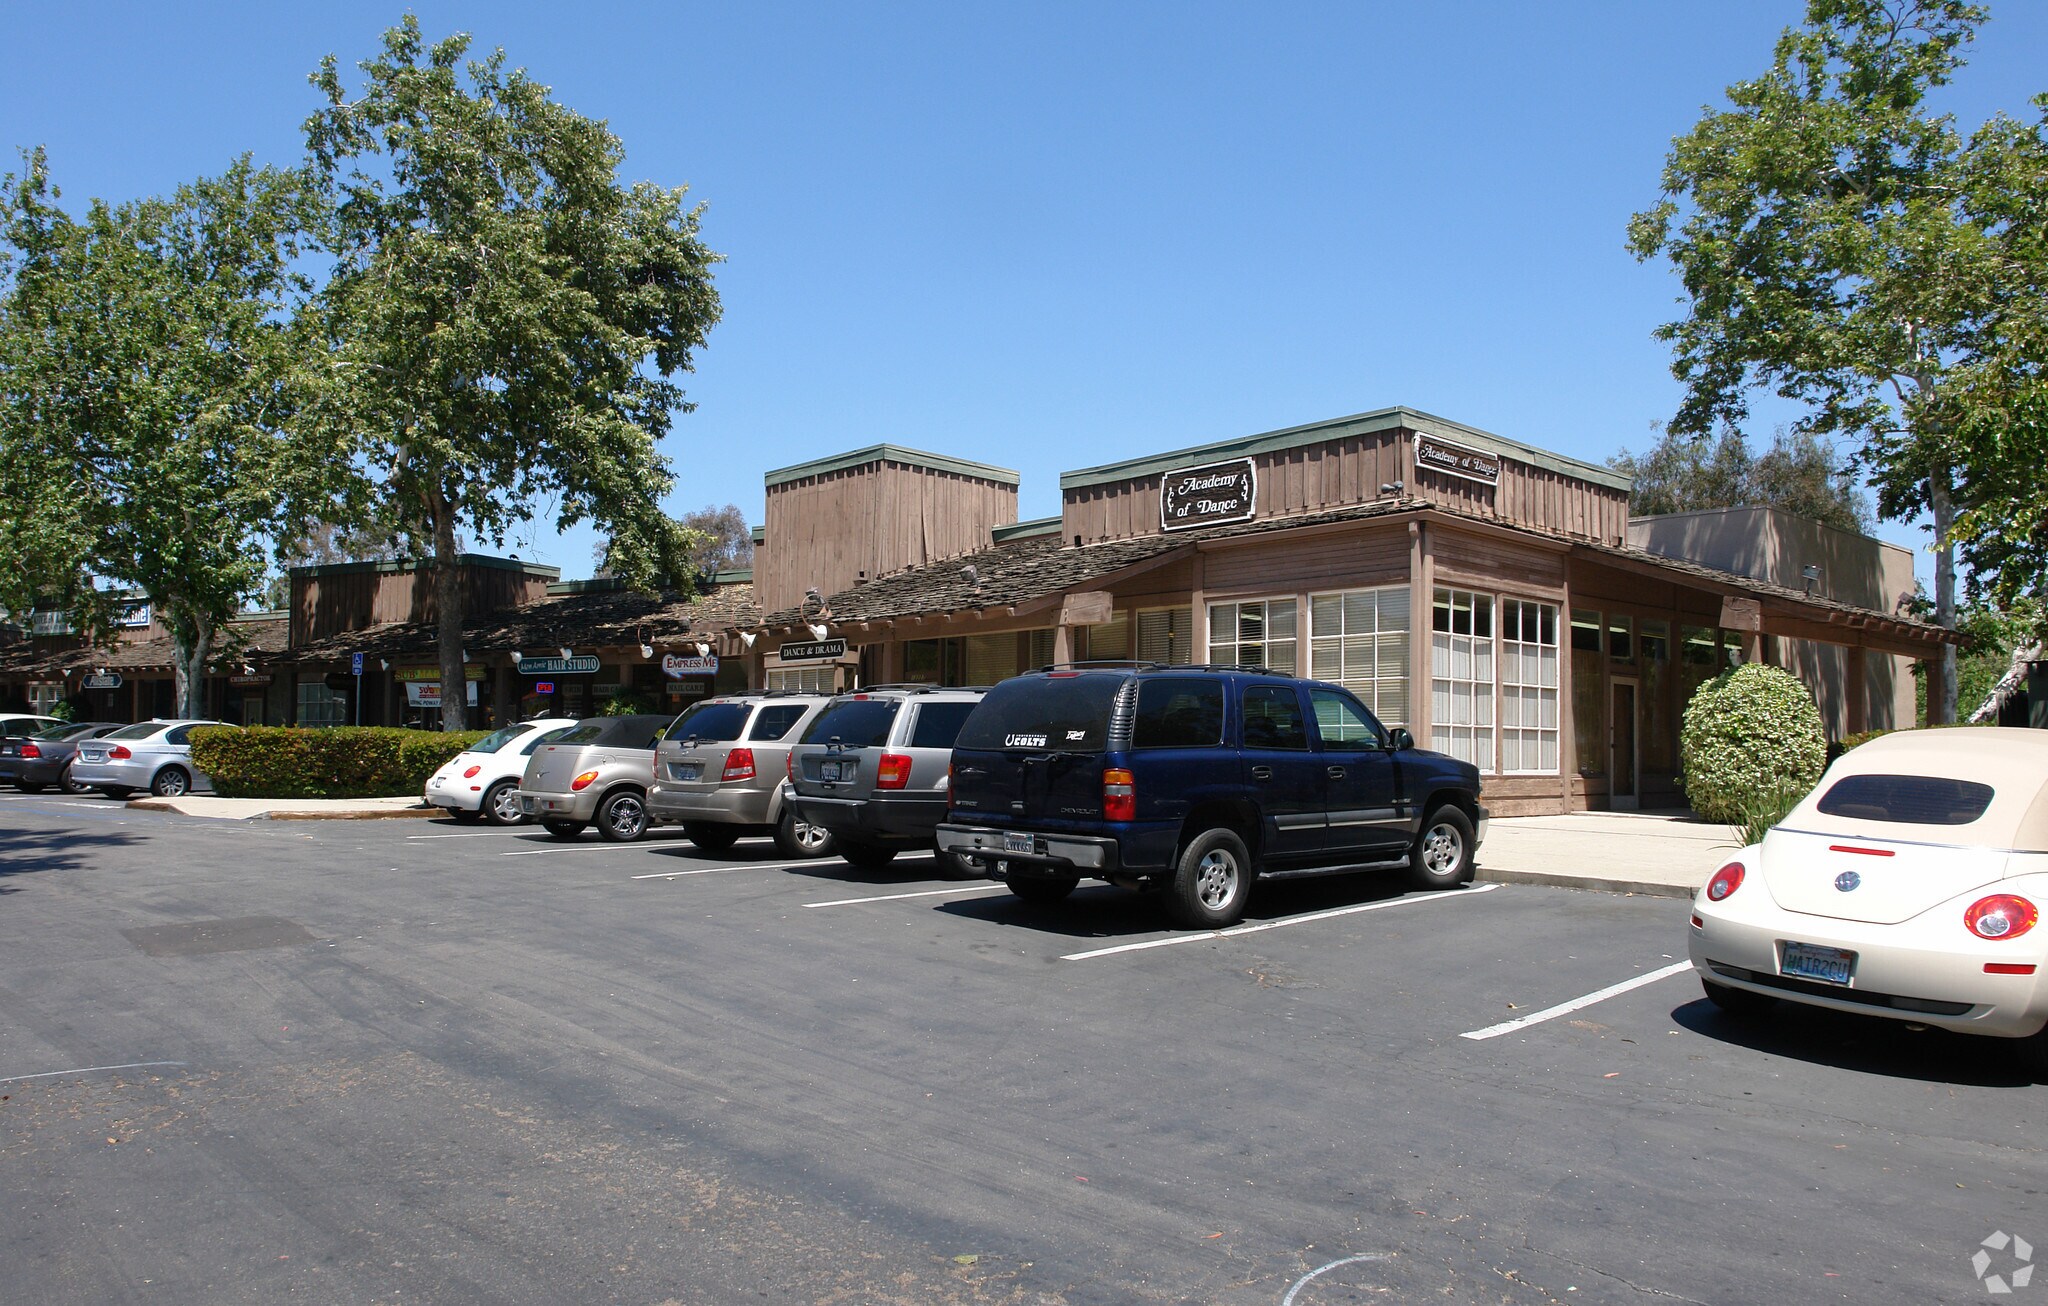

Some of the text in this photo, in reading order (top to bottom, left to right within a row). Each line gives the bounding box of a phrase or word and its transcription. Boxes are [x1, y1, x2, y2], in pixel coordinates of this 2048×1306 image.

[1420, 444, 1497, 476] Academy of Dance
[1178, 474, 1238, 495] Academy
[1177, 500, 1238, 517] of Dance
[783, 645, 842, 657] DANCE & DRAMA
[547, 660, 566, 671] HAIR
[567, 658, 597, 670] STUDIO
[666, 657, 702, 669] EMPRESS
[418, 669, 441, 679] MAR
[685, 684, 704, 692] CARE
[1014, 738, 1047, 747] COLTS
[1786, 953, 1848, 979] HAIR2CU
